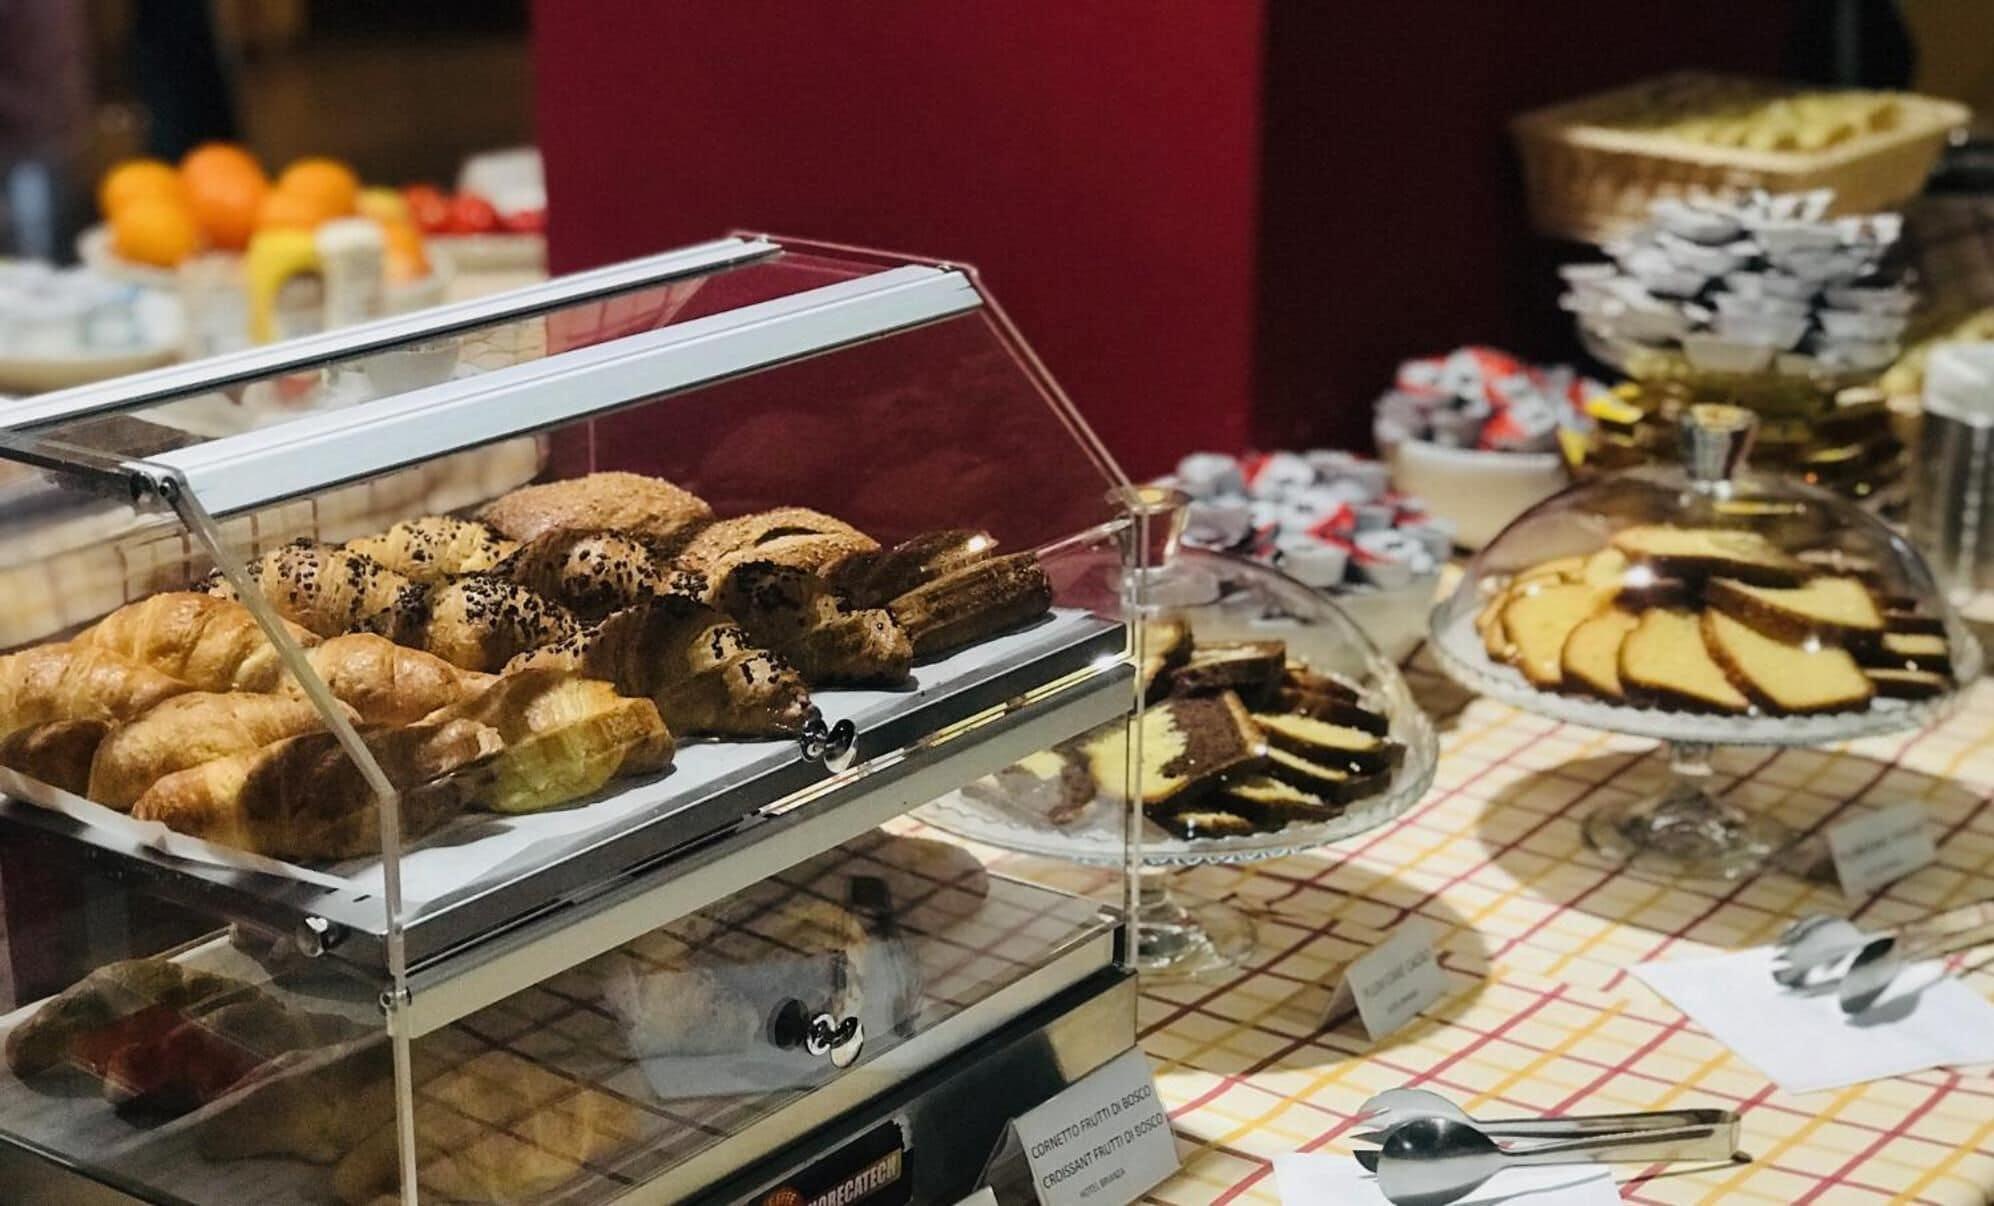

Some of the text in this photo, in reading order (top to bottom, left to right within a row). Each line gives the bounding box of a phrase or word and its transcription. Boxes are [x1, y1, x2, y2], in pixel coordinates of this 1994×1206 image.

[1031, 1084, 1152, 1159] CORNETTO FRUTTI DI BOSCO
[1042, 1112, 1164, 1189] CROISSANT FRUTTI DI BOSCO
